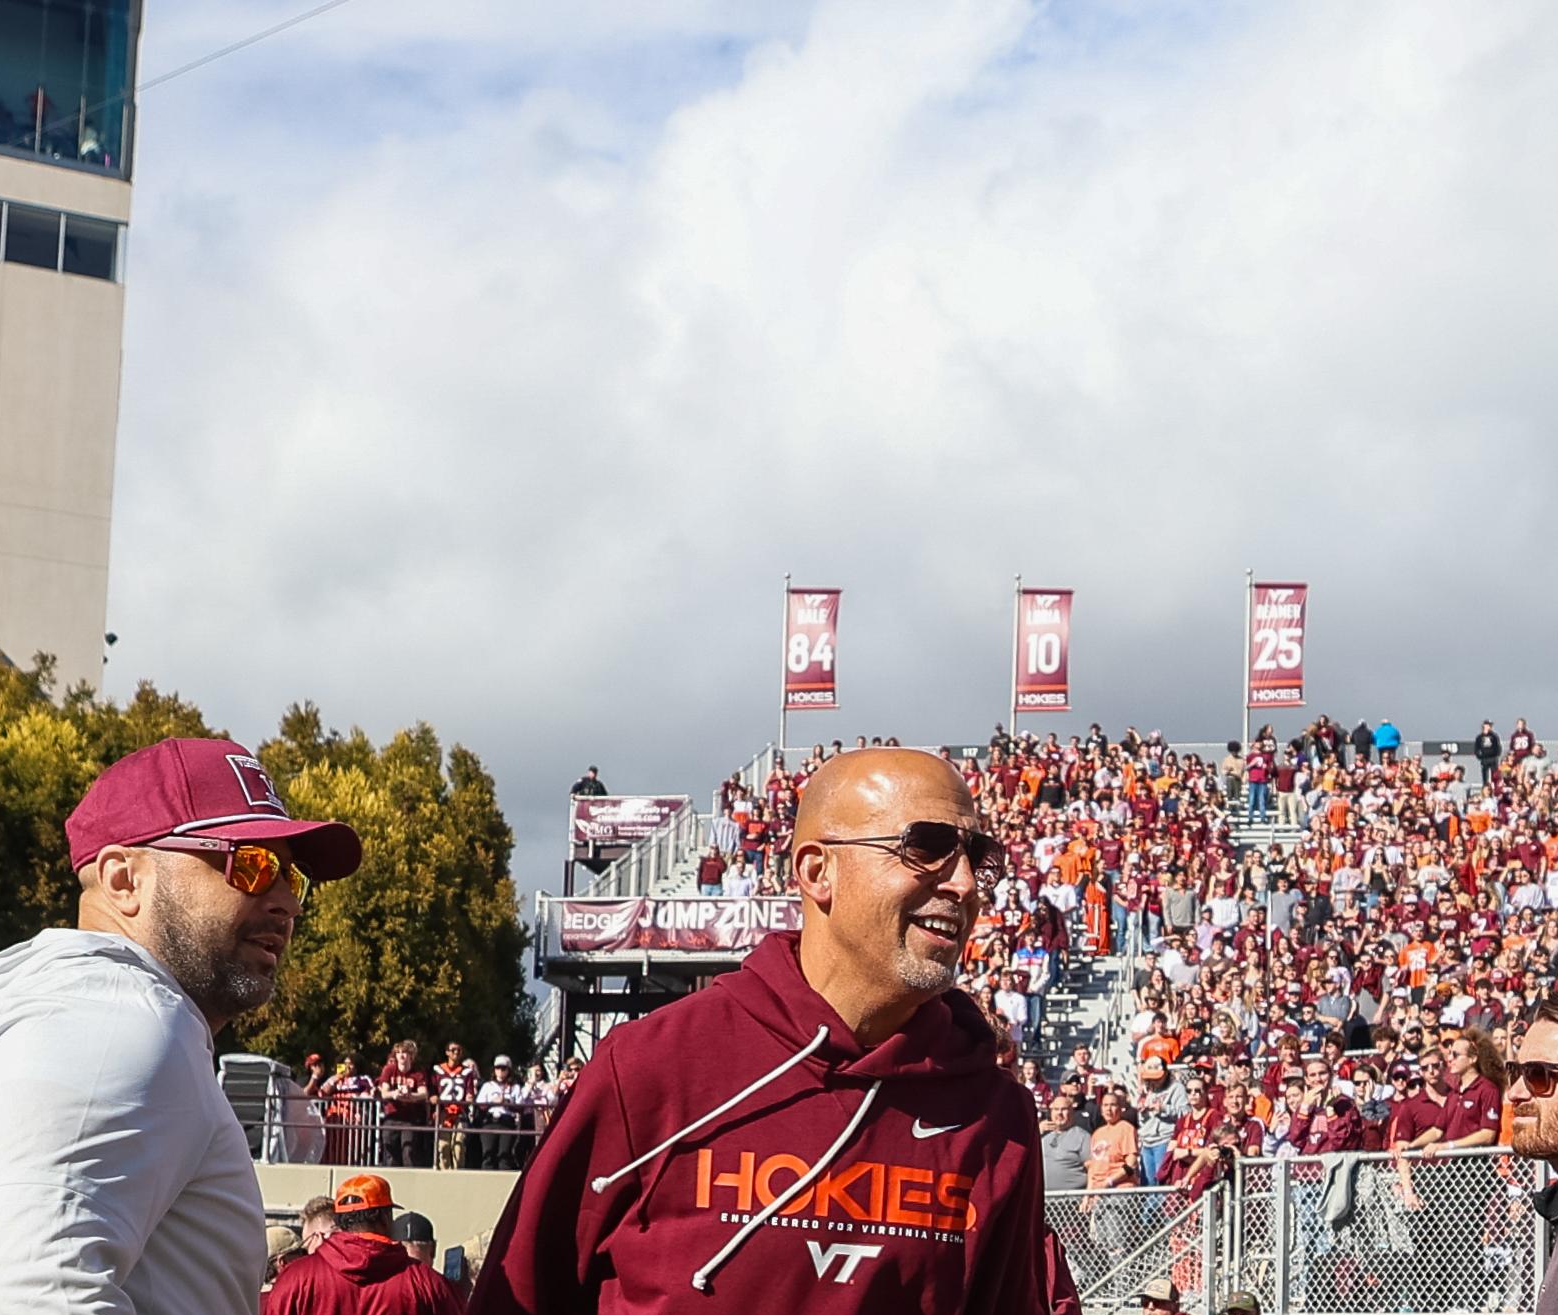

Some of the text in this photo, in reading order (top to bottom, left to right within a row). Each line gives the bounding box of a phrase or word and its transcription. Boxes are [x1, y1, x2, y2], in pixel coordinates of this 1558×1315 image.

[787, 632, 834, 673] 84
[1027, 632, 1060, 675] 10
[1252, 627, 1303, 671] 25
[787, 691, 834, 703] HOKIES
[1018, 693, 1066, 705] HOKIES
[1252, 688, 1301, 702] HOKIES
[1003, 910, 1022, 927] 32
[441, 1080, 465, 1101] 25
[696, 1148, 977, 1231] HOKIES
[827, 1221, 854, 1233] FOR
[861, 1224, 928, 1241] VIRGINIA
[934, 1231, 961, 1244] TECH
[806, 1240, 885, 1285] VT
